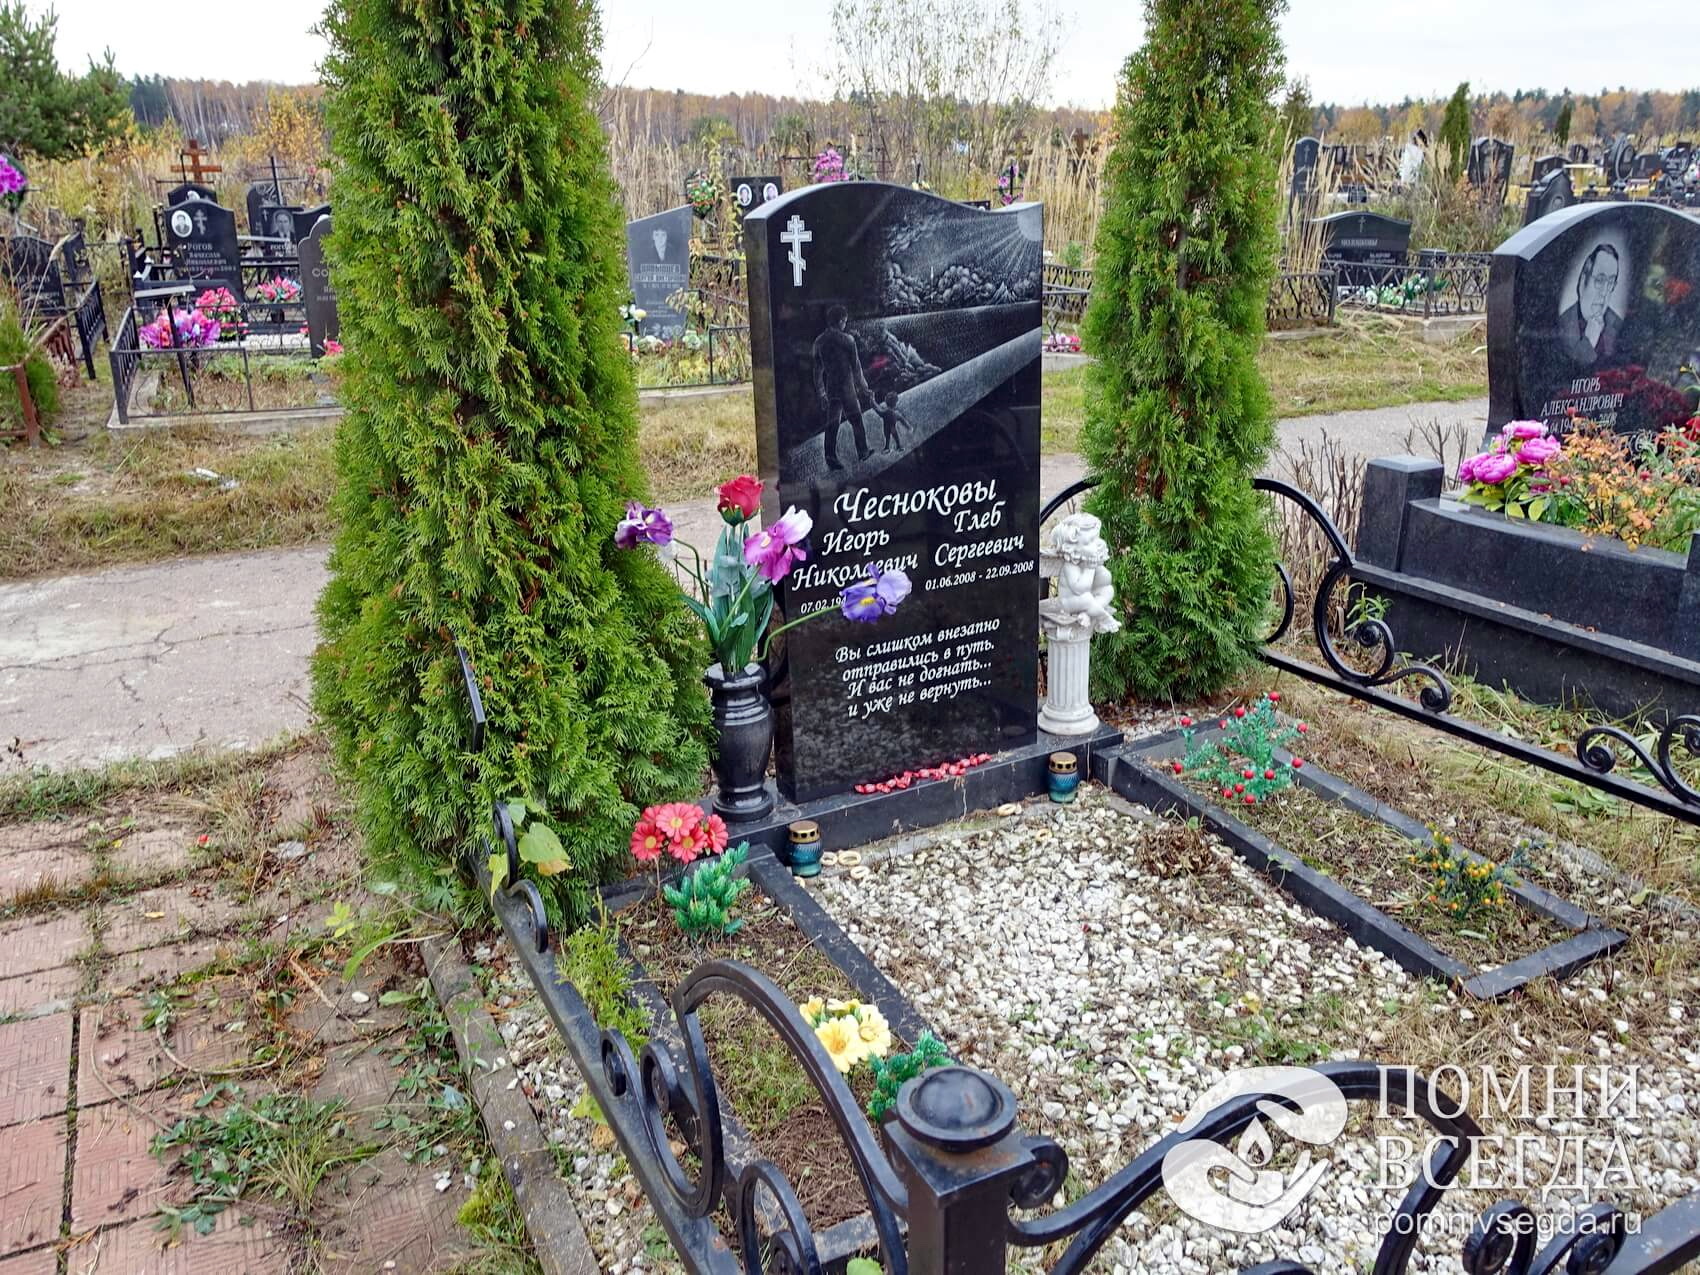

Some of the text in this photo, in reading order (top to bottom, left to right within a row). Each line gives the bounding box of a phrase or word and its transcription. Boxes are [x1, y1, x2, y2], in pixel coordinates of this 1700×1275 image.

[1571, 377, 1601, 395] ИГОРЬ
[834, 479, 997, 523] Чесноковы
[954, 501, 1006, 533] Глеб
[821, 528, 890, 556] Игорь
[934, 535, 1024, 568] Сергеевич
[925, 572, 977, 592] 01.06.2008
[985, 559, 1035, 581] 22.09.2008
[835, 618, 1000, 664] Вы слишком внезапно
[842, 639, 995, 681] отправились в путь.
[847, 678, 866, 699] И
[868, 677, 893, 694] вас
[898, 672, 914, 688] не
[848, 703, 858, 718] и
[861, 695, 893, 720] уже
[898, 691, 915, 706] не
